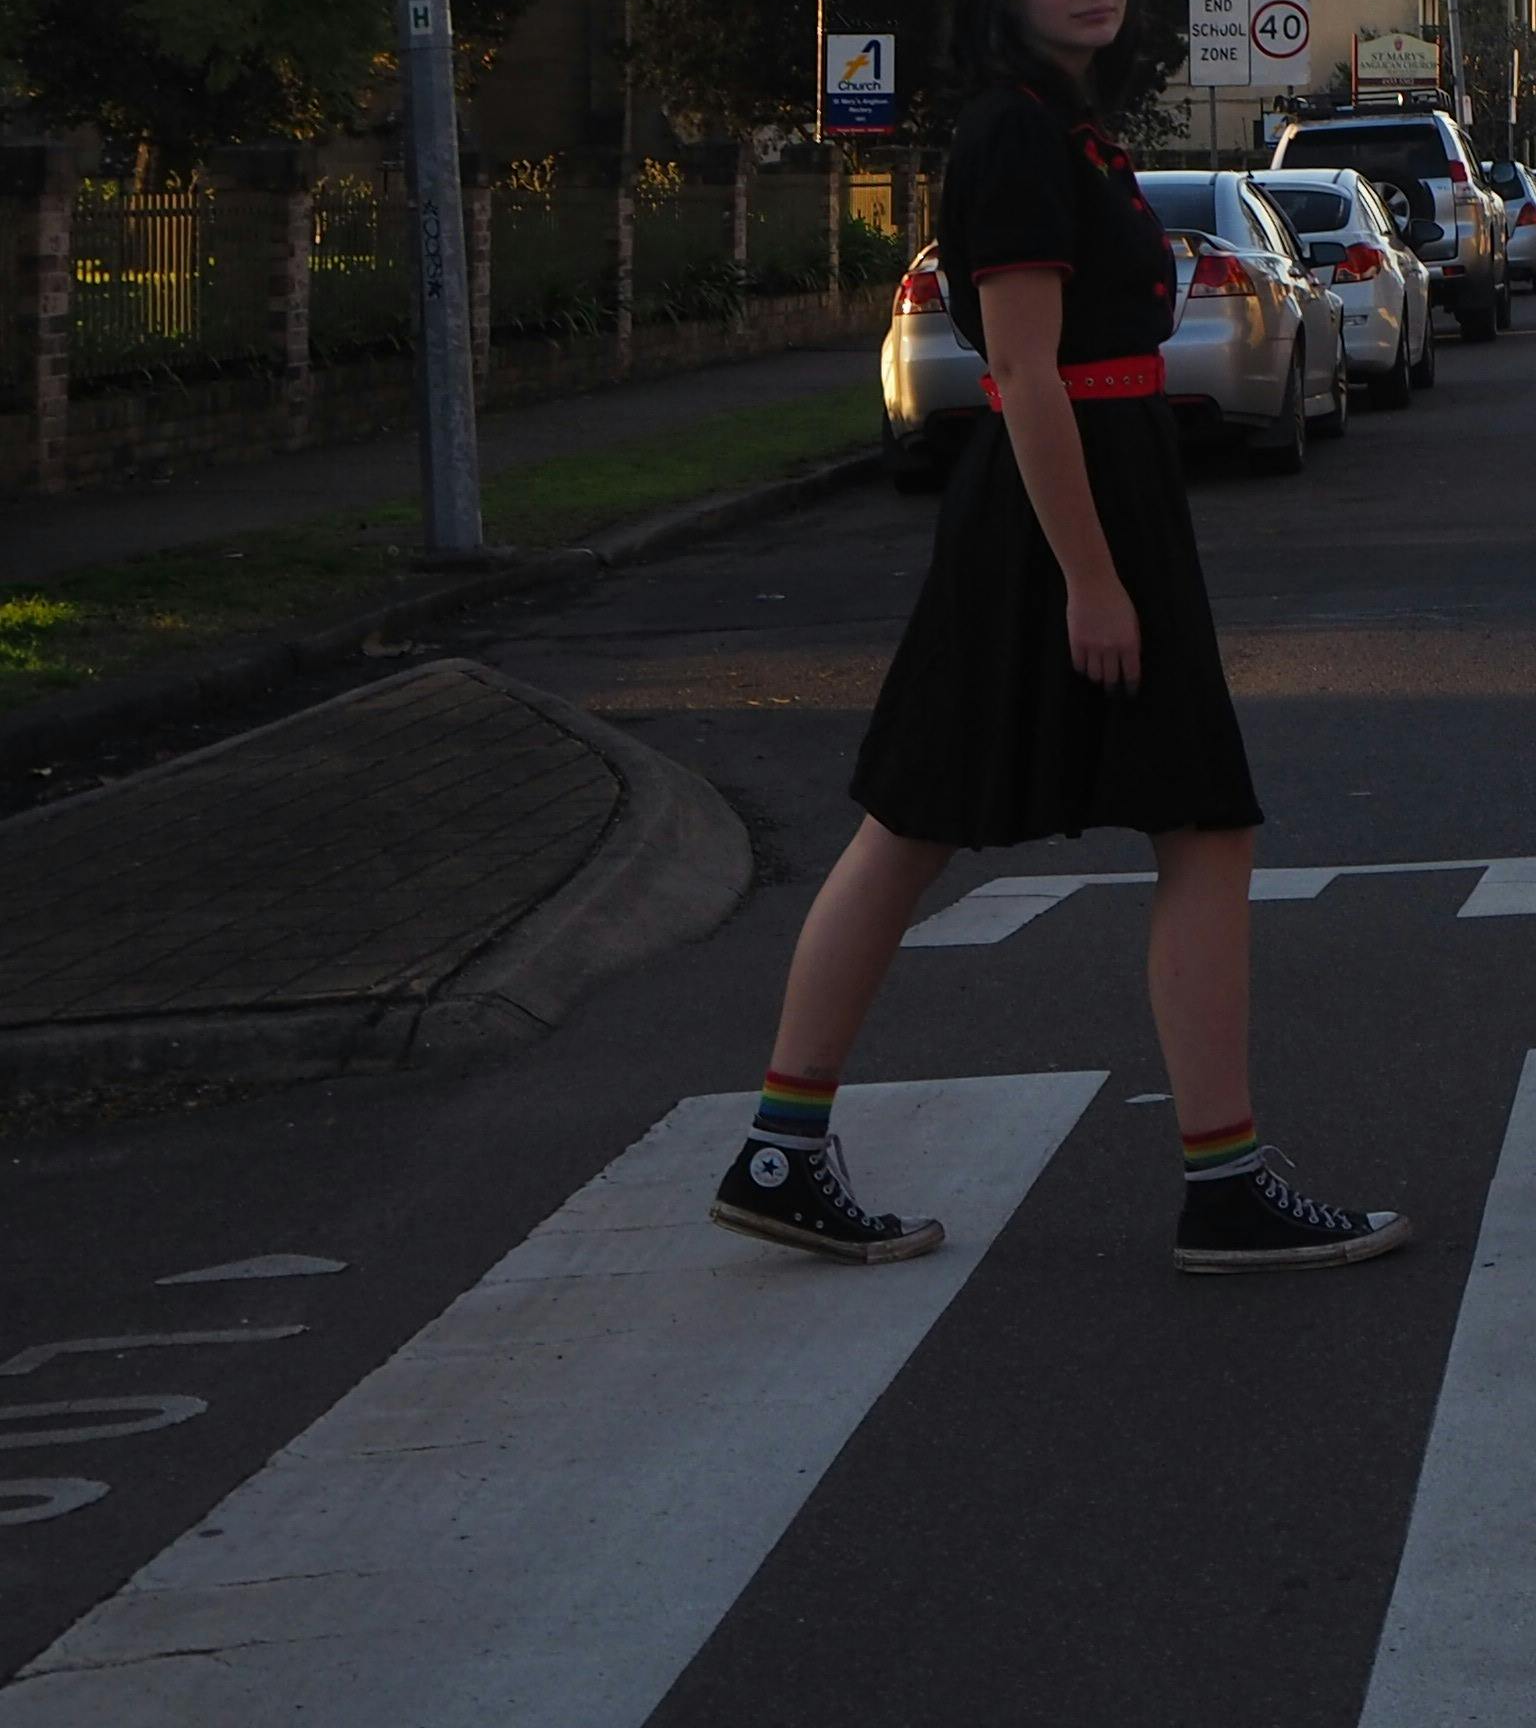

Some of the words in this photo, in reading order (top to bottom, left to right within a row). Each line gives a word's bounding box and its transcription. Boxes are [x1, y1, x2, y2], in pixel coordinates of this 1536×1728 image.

[413, 6, 429, 29] H
[1191, 23, 1247, 38] SCHOOL
[1258, 14, 1301, 40] 40
[1200, 47, 1238, 61] ZONE
[838, 80, 881, 92] Church
